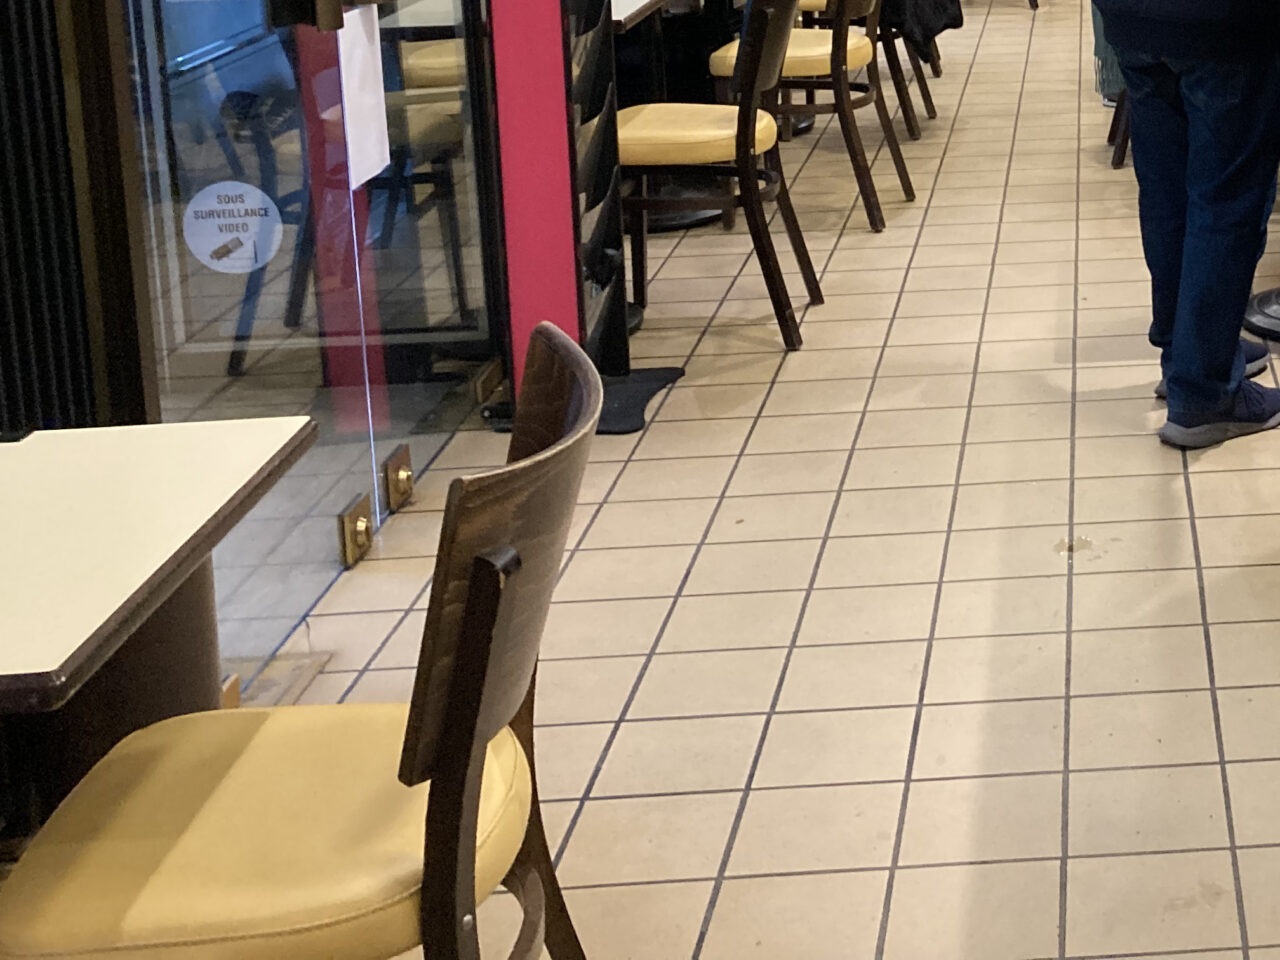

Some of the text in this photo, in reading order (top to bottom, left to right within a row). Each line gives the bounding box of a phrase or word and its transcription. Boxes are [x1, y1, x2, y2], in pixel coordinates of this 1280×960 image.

[216, 193, 246, 205] SOUS
[193, 207, 271, 220] SURVEILLANCE
[217, 222, 250, 233] VIDEO
